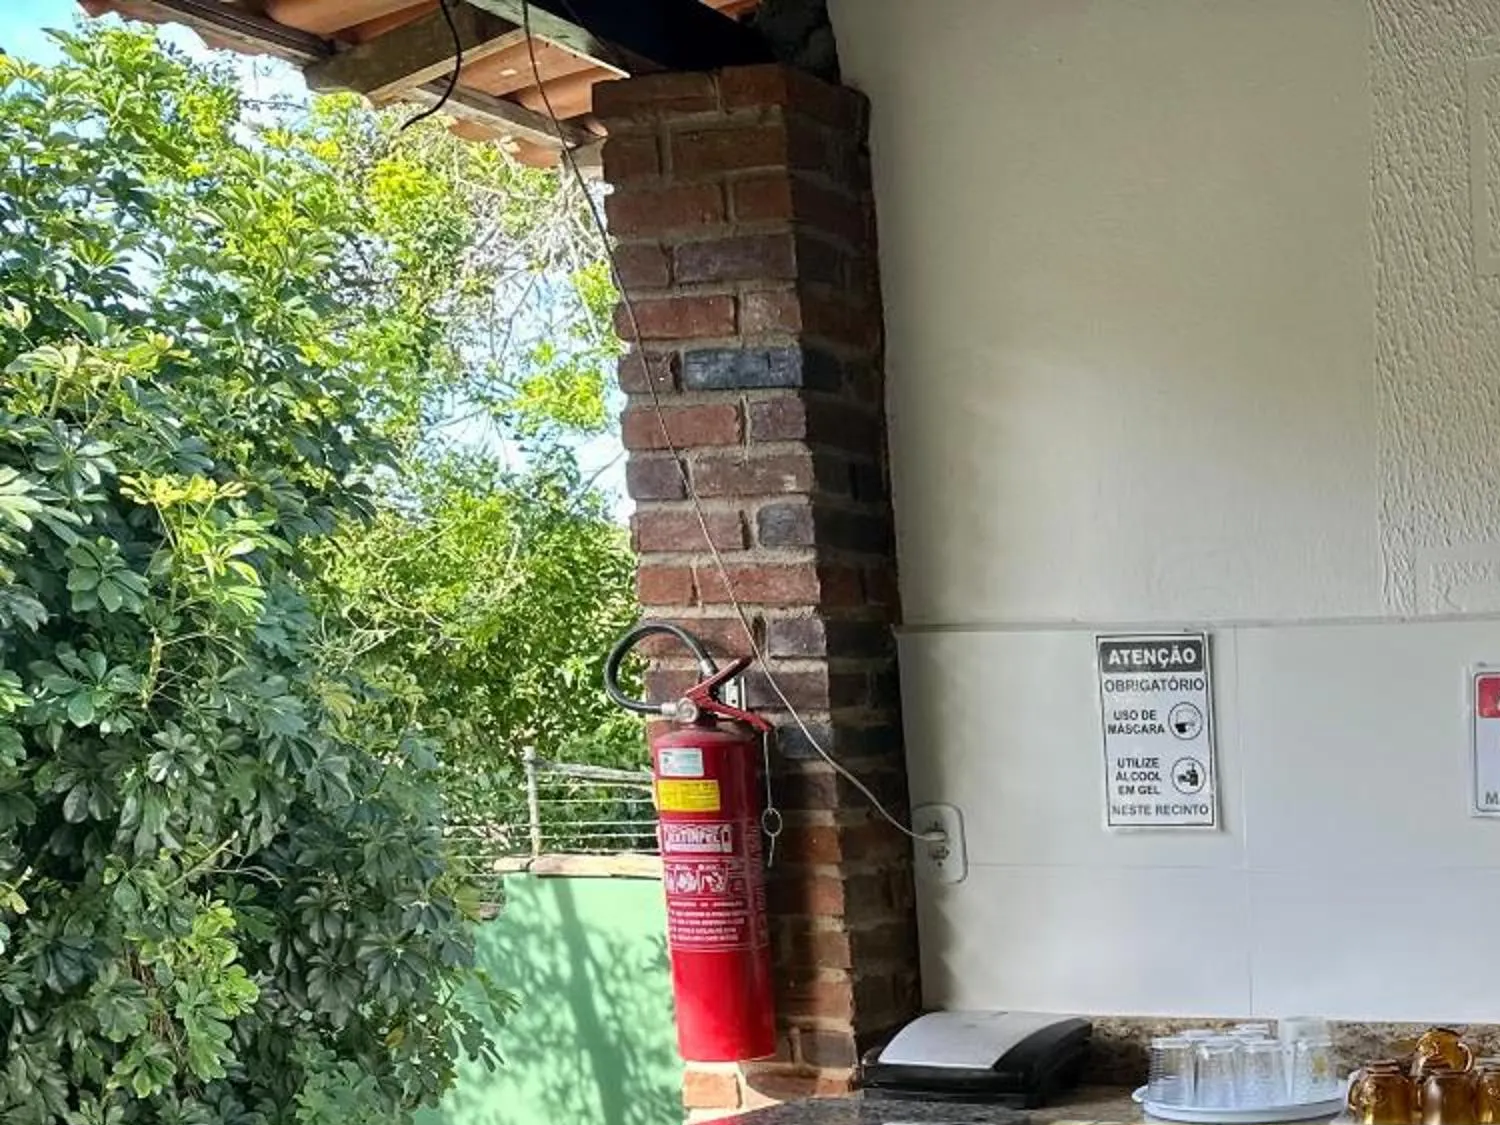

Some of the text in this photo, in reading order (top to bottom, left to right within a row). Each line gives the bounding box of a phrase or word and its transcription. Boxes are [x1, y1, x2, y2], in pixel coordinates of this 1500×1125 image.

[1108, 645, 1197, 668] ATENÇÃO
[1104, 676, 1205, 693] OBRIGATÓRIO
[1113, 709, 1157, 721] USO DE
[1117, 757, 1160, 769] UTILIZE
[1118, 784, 1161, 796] EM GEL
[1112, 803, 1209, 817] NESTE RECINTO
